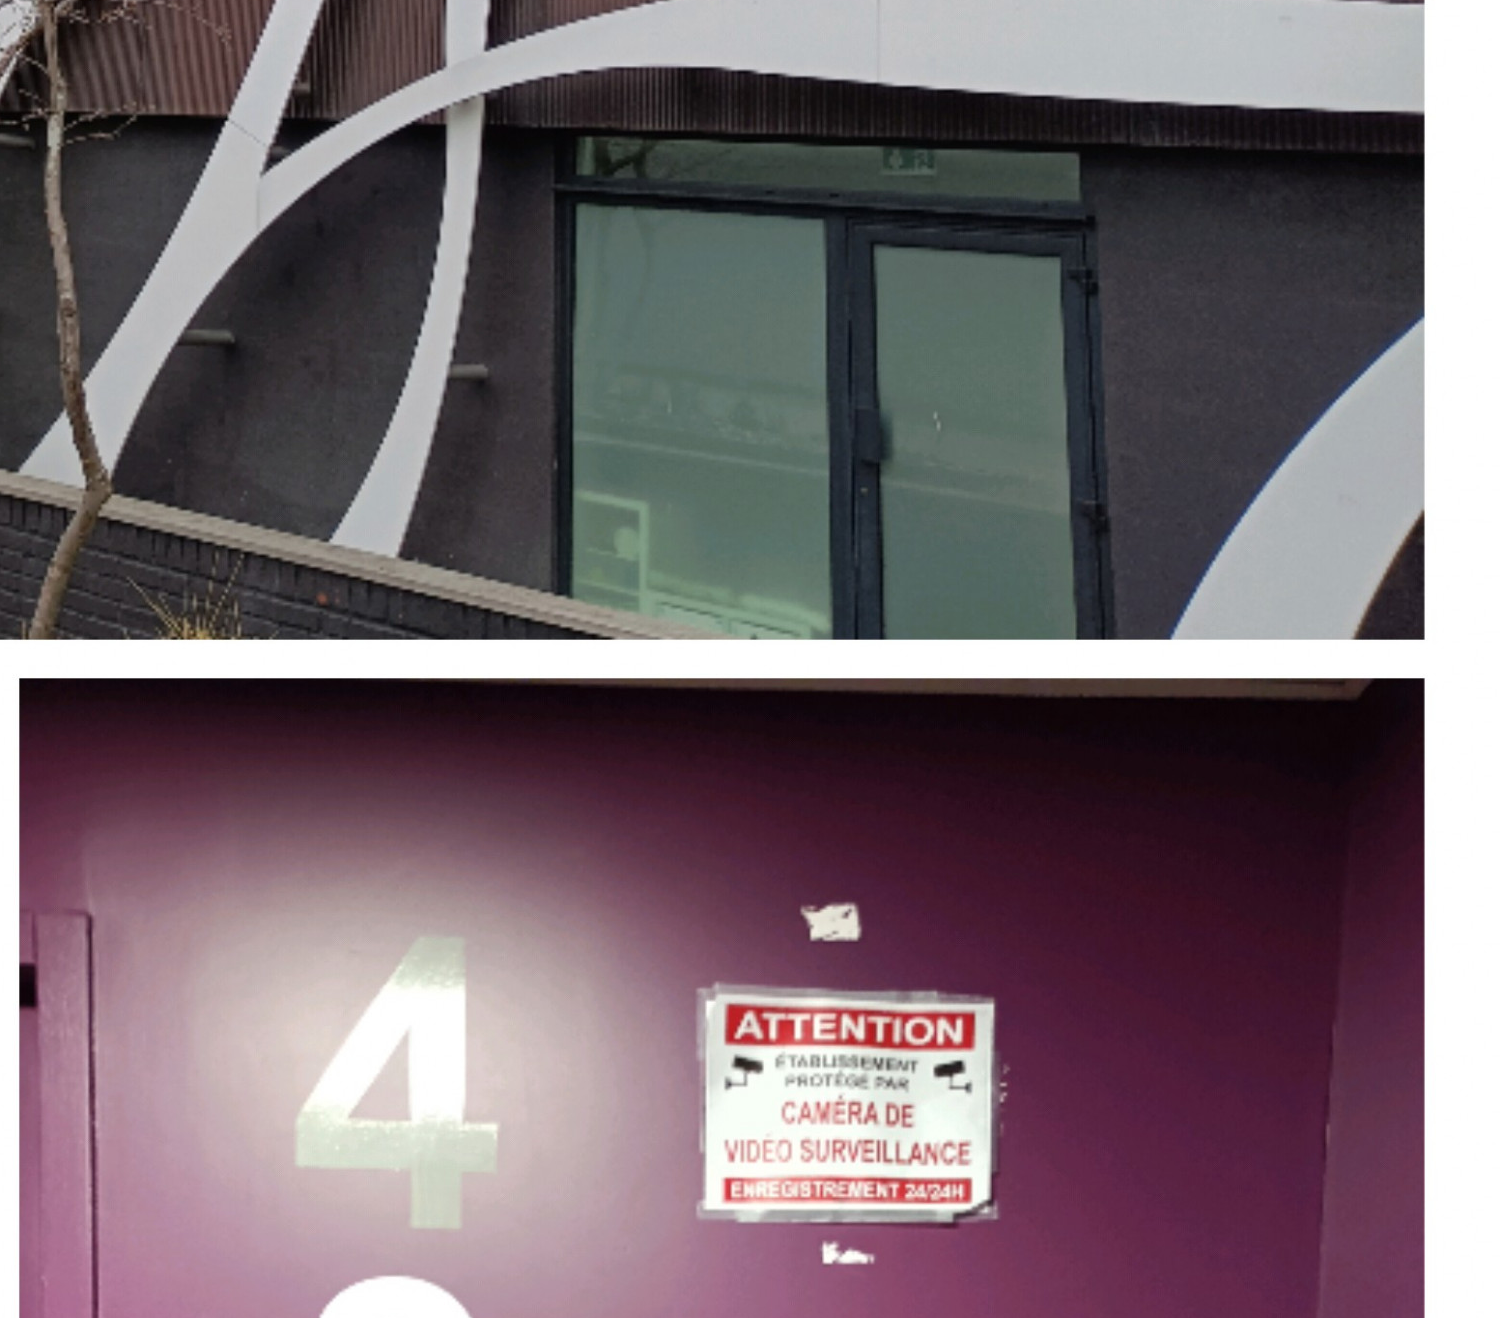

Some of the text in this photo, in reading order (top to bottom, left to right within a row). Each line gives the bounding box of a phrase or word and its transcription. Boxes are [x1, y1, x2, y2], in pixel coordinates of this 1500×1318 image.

[733, 1010, 965, 1046] ATTENTION
[774, 1052, 918, 1074] ÉTABLISSEMENT
[295, 937, 498, 1230] 4
[874, 1075, 910, 1092] PAR
[781, 1093, 915, 1128] CAMÉRA DE
[800, 1138, 972, 1166] SURVEILLANCE
[729, 1181, 965, 1201] ENREGISTREMENT 24/24H
